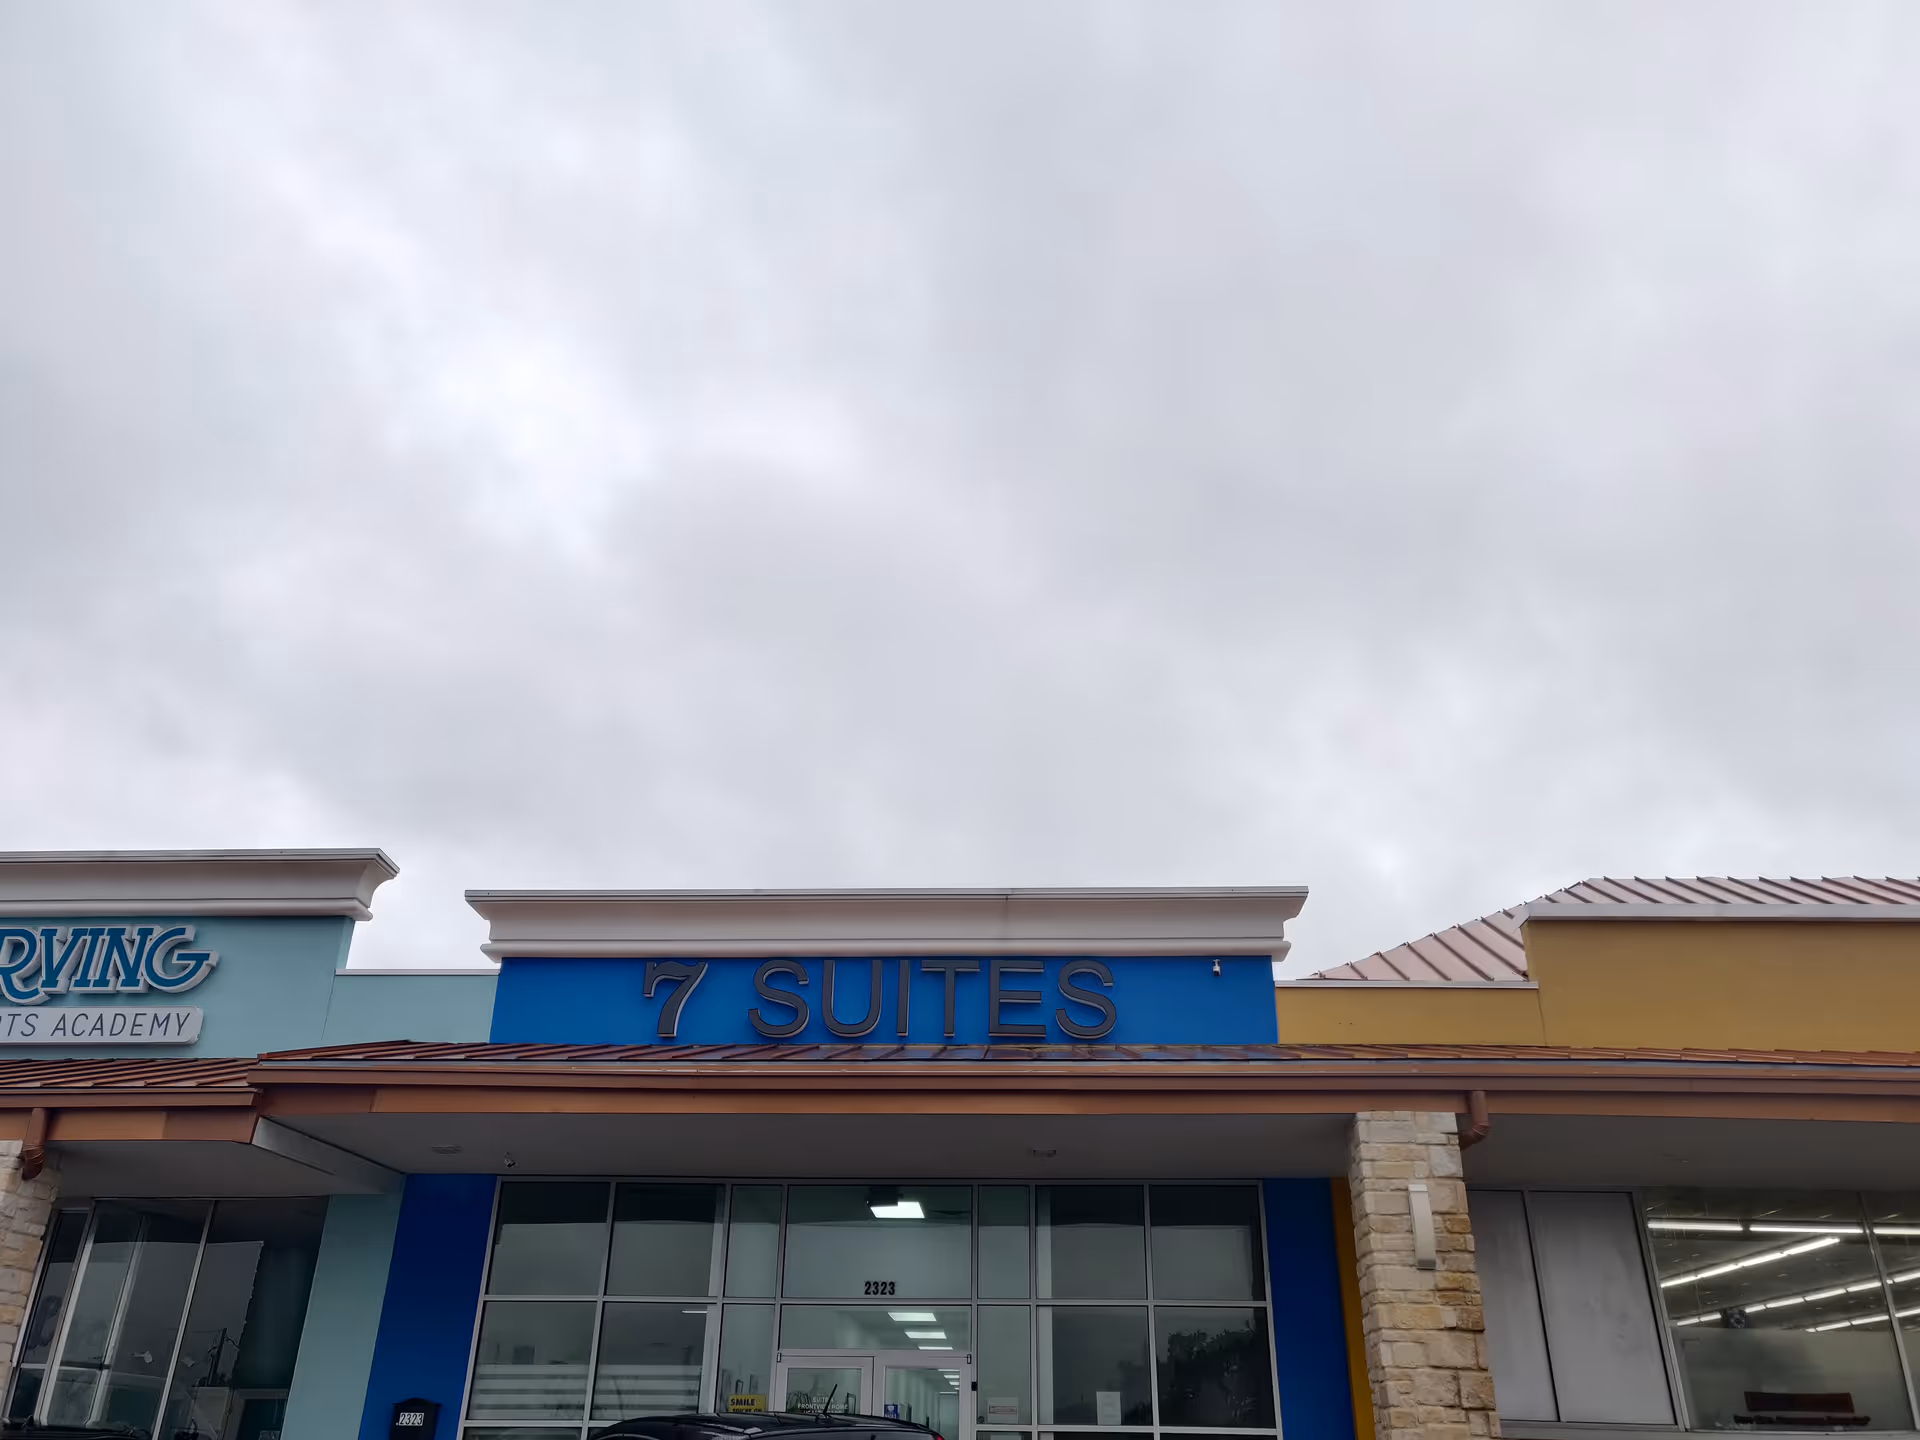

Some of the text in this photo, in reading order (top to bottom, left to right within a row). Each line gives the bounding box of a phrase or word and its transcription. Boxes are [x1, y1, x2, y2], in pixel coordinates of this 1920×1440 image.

[642, 960, 1117, 1039] 7 SUITES
[50, 1012, 191, 1037] ACADEMY
[864, 1281, 896, 1296] 2323
[730, 1398, 756, 1407] SMILE
[400, 1413, 423, 1426] 2323
